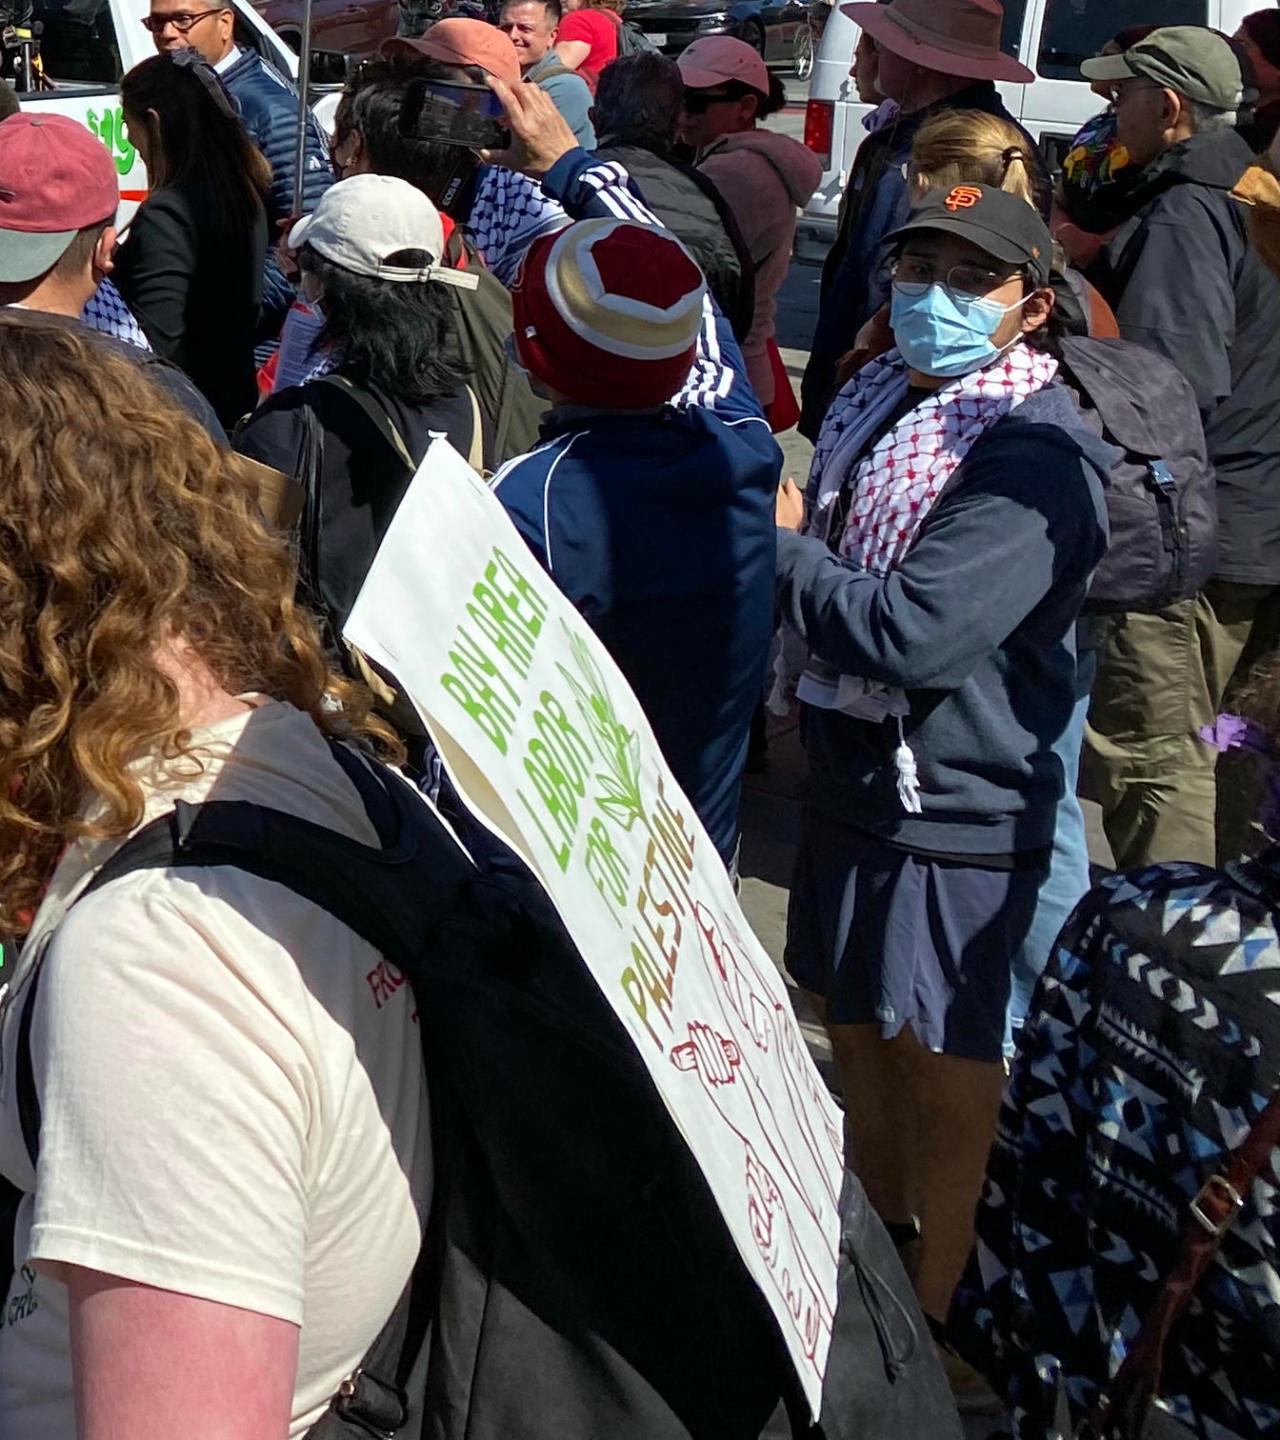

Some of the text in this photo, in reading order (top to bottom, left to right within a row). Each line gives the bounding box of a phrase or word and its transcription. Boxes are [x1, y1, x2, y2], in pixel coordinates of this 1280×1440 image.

[944, 185, 983, 212] SF
[440, 546, 548, 757] BAY AREA
[516, 690, 593, 875] LABOR
[585, 817, 630, 929] FOR
[620, 775, 695, 1053] PALESTINE
